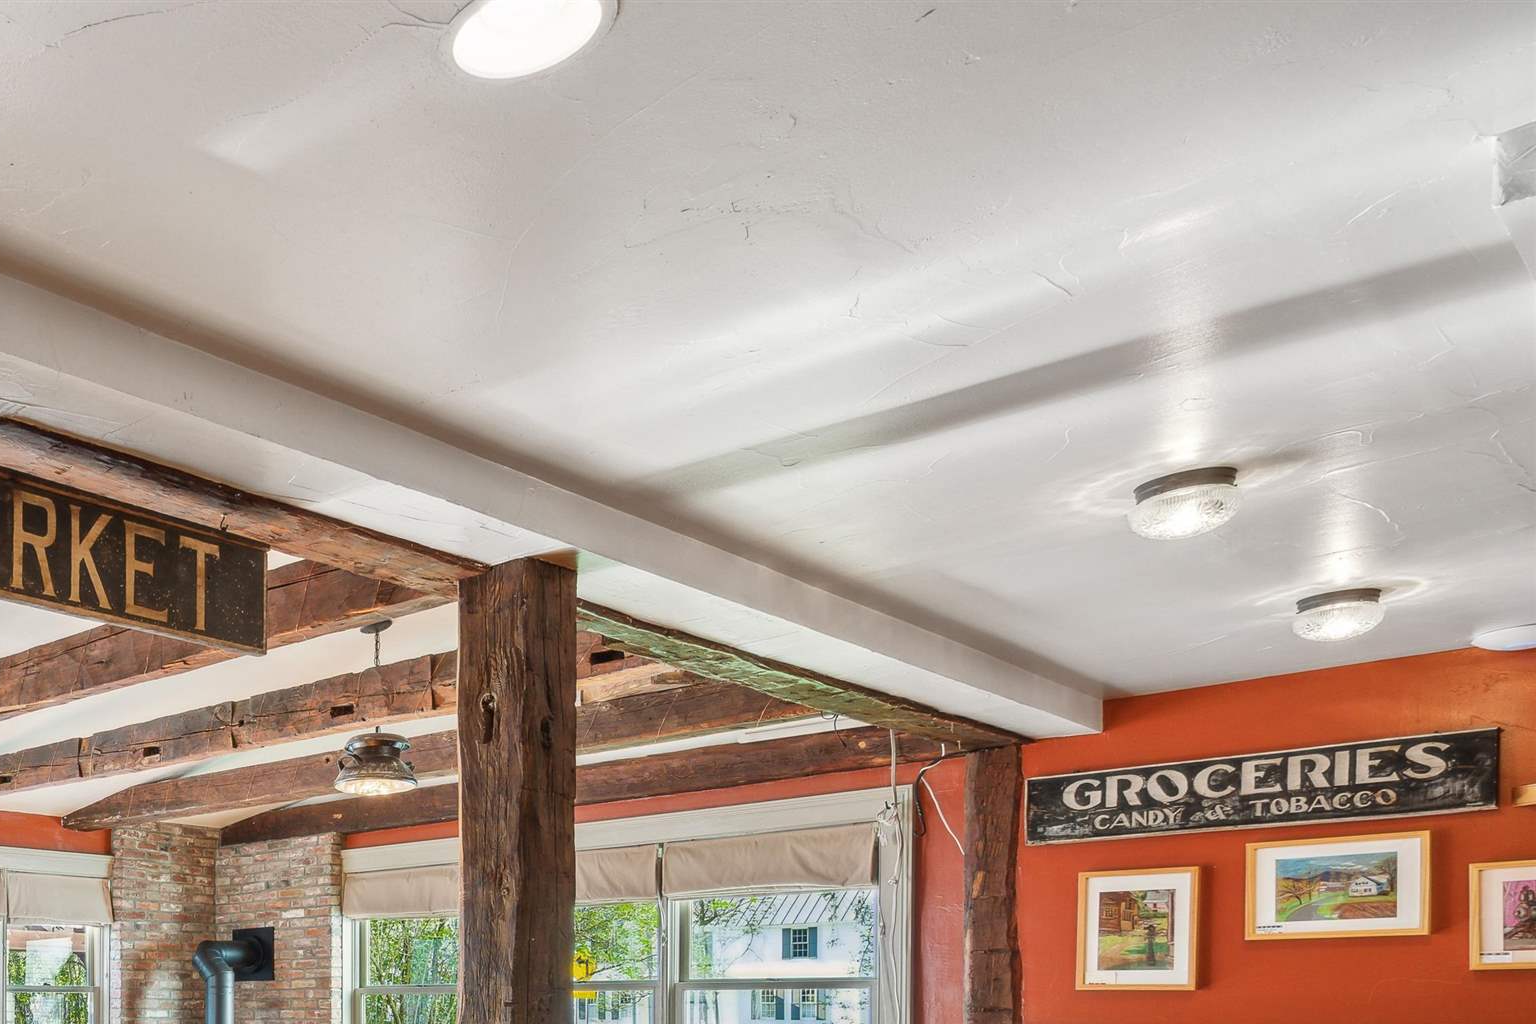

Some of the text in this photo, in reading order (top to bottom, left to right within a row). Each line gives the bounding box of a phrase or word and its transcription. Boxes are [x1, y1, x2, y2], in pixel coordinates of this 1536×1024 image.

[1062, 741, 1453, 811] GROCERIES
[1093, 788, 1397, 830] CANDY & TOBACCO
